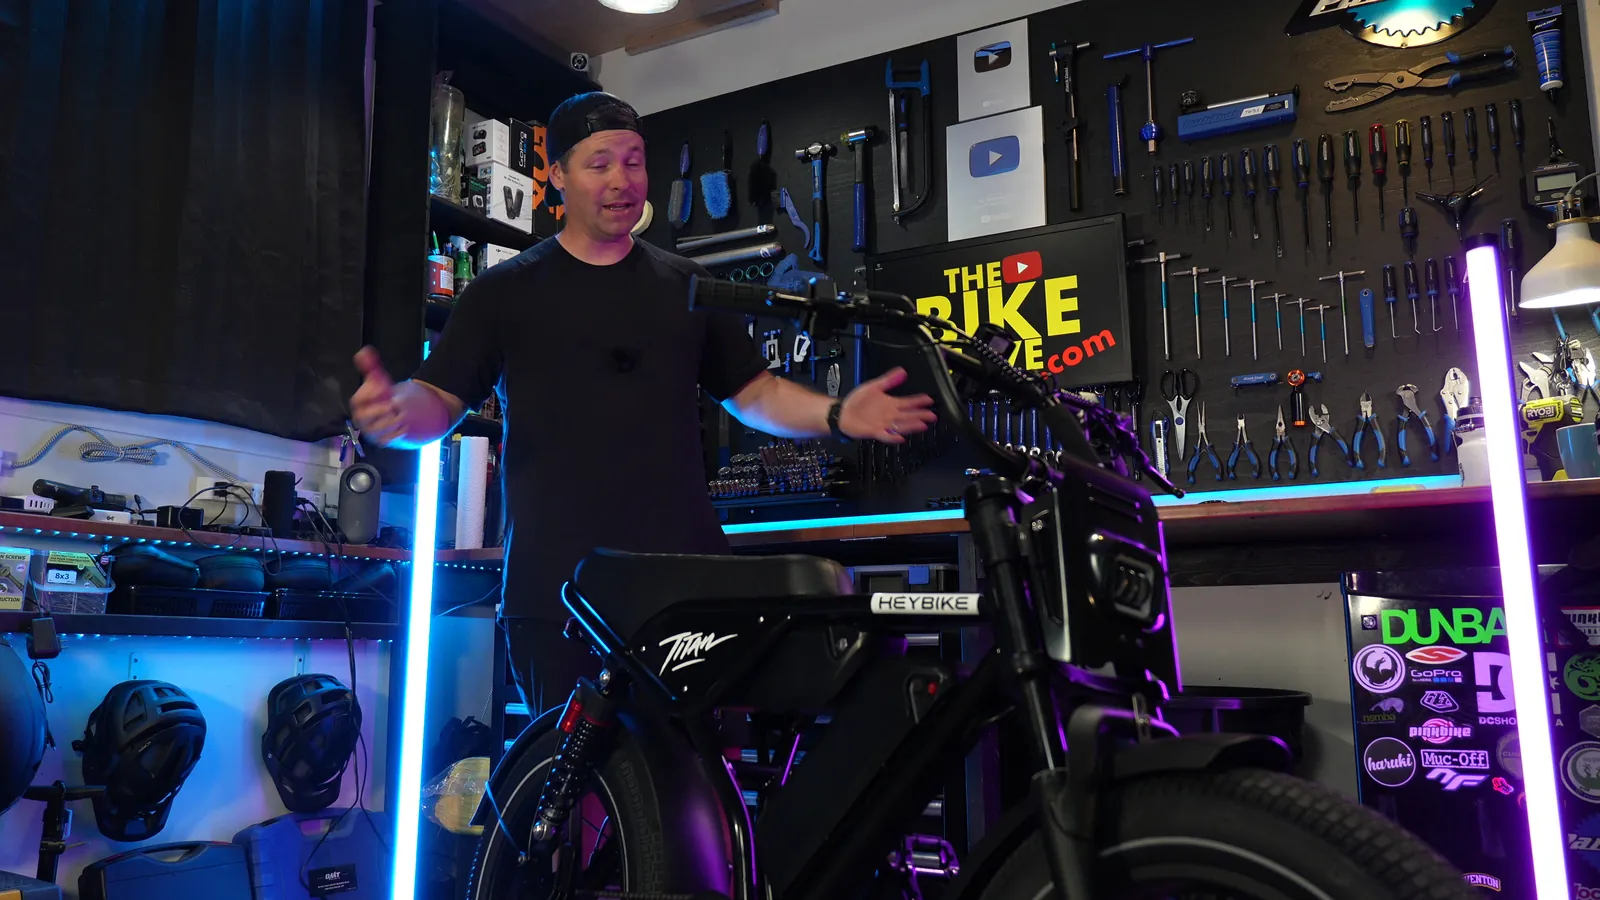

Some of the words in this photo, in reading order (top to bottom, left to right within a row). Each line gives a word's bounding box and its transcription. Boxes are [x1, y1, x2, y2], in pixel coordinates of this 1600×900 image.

[943, 261, 1003, 294] THE
[916, 275, 1081, 342] BIKE
[1041, 328, 1116, 380] .com
[1527, 405, 1555, 418] RYOBI
[54, 572, 70, 580] 8x3
[879, 596, 970, 611] HEYBIKE
[1381, 607, 1508, 645] DUNBA
[1410, 669, 1462, 678] GoPro
[1478, 716, 1517, 726] DCSHO
[1367, 754, 1413, 772] haruki
[1423, 752, 1486, 767] Muc-Off
